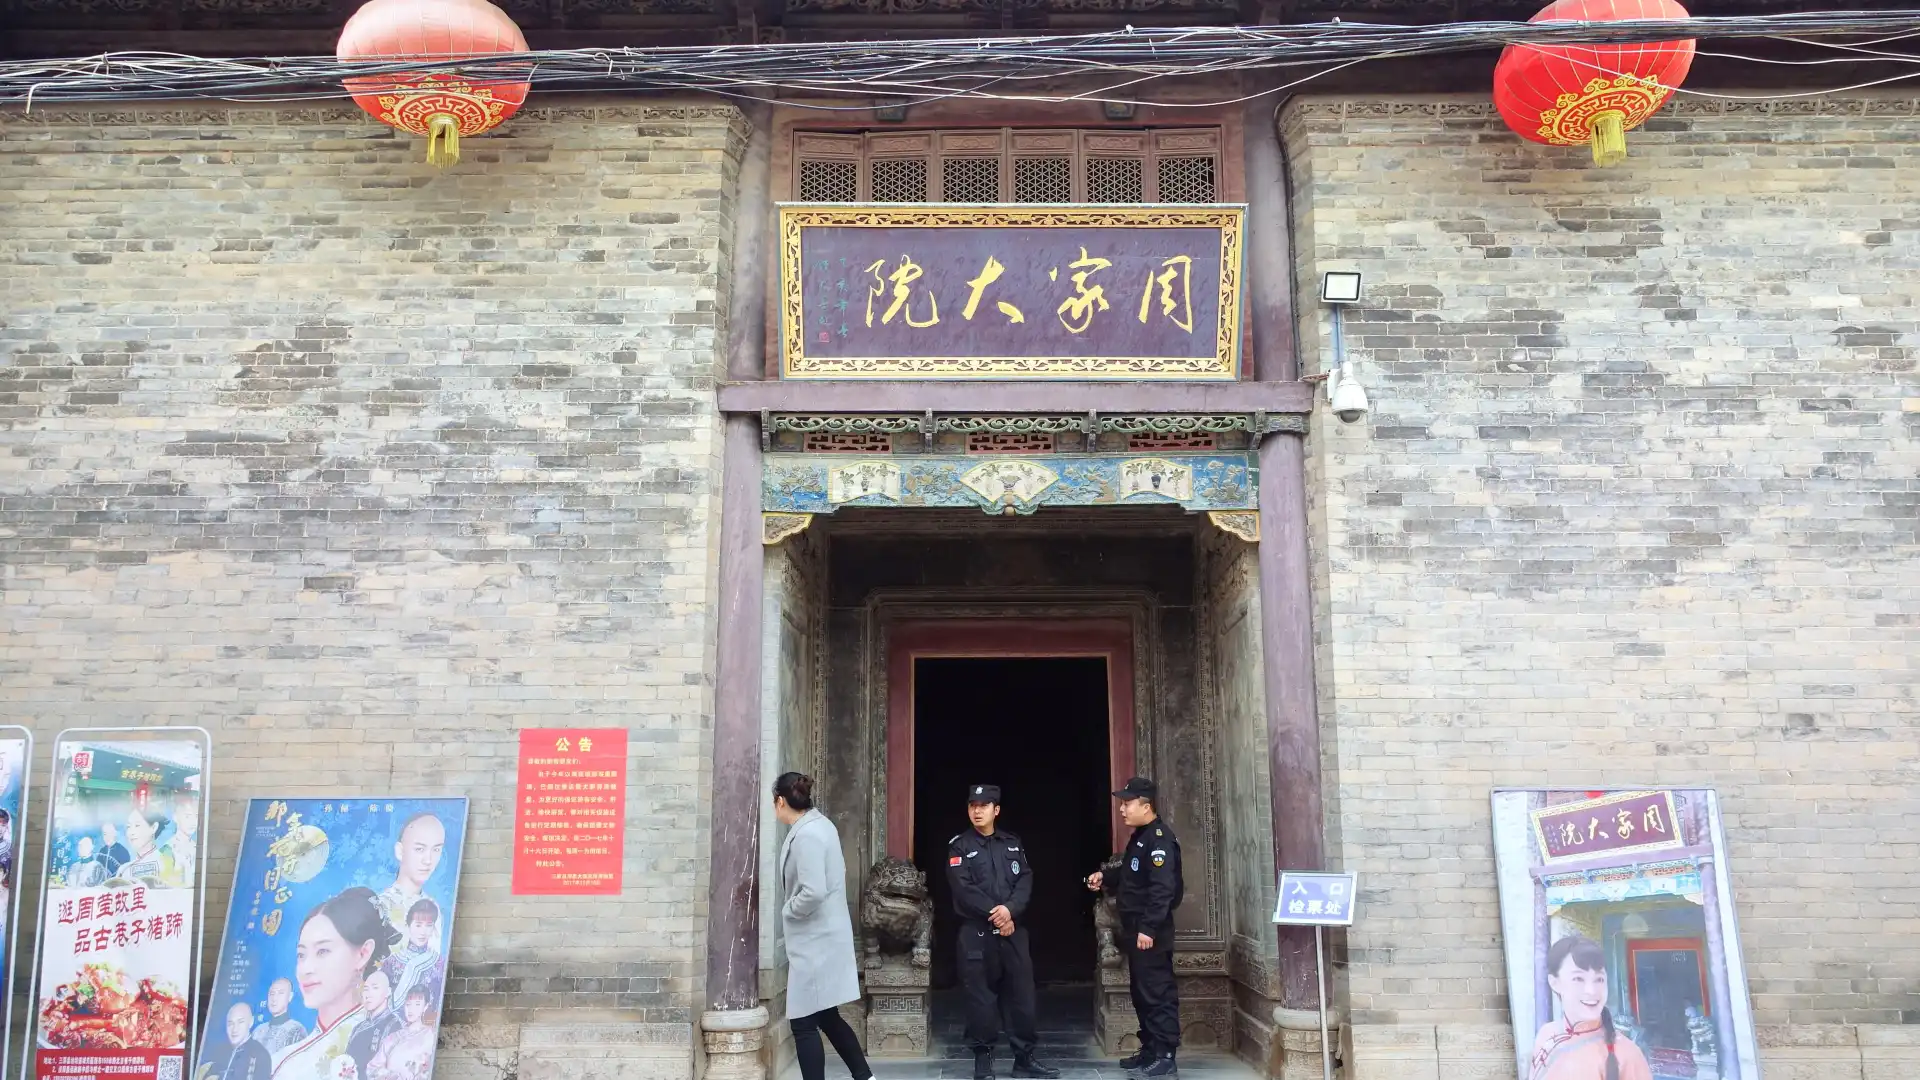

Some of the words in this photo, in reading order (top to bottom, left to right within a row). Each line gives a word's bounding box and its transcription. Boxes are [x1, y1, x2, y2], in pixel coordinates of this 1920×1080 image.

[864, 247, 1194, 334] 周家大院
[555, 737, 593, 752] 公告
[1558, 804, 1666, 847] 周家大院
[57, 886, 147, 924] 逛周莹故里
[1288, 899, 1342, 915] 检票处
[1291, 881, 1344, 895] 入口
[73, 911, 183, 955] 品古巷子猪蹄
